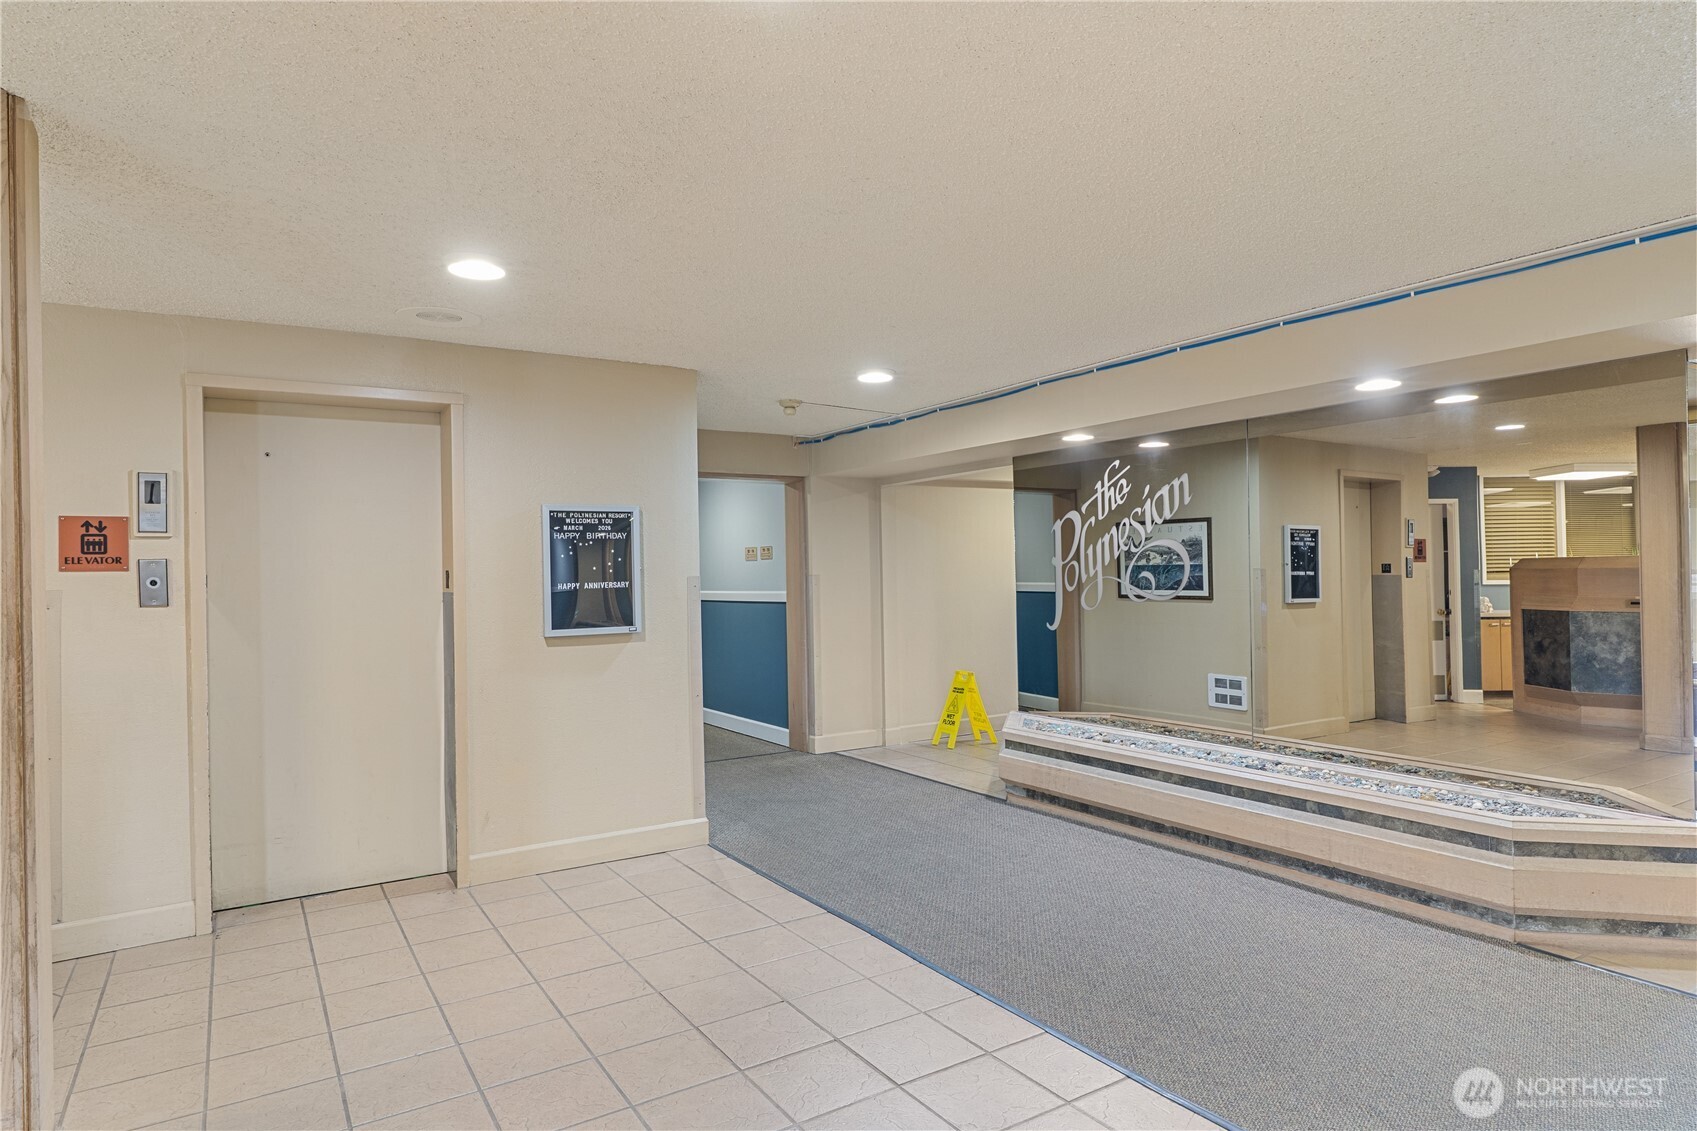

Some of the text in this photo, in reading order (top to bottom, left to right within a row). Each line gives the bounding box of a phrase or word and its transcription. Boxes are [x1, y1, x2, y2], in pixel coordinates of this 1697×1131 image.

[1081, 459, 1132, 521] the
[64, 556, 123, 565] ELEVATOR
[1046, 472, 1193, 631] Polynesian
[557, 581, 629, 590] HAPPY ANNIVERSARY
